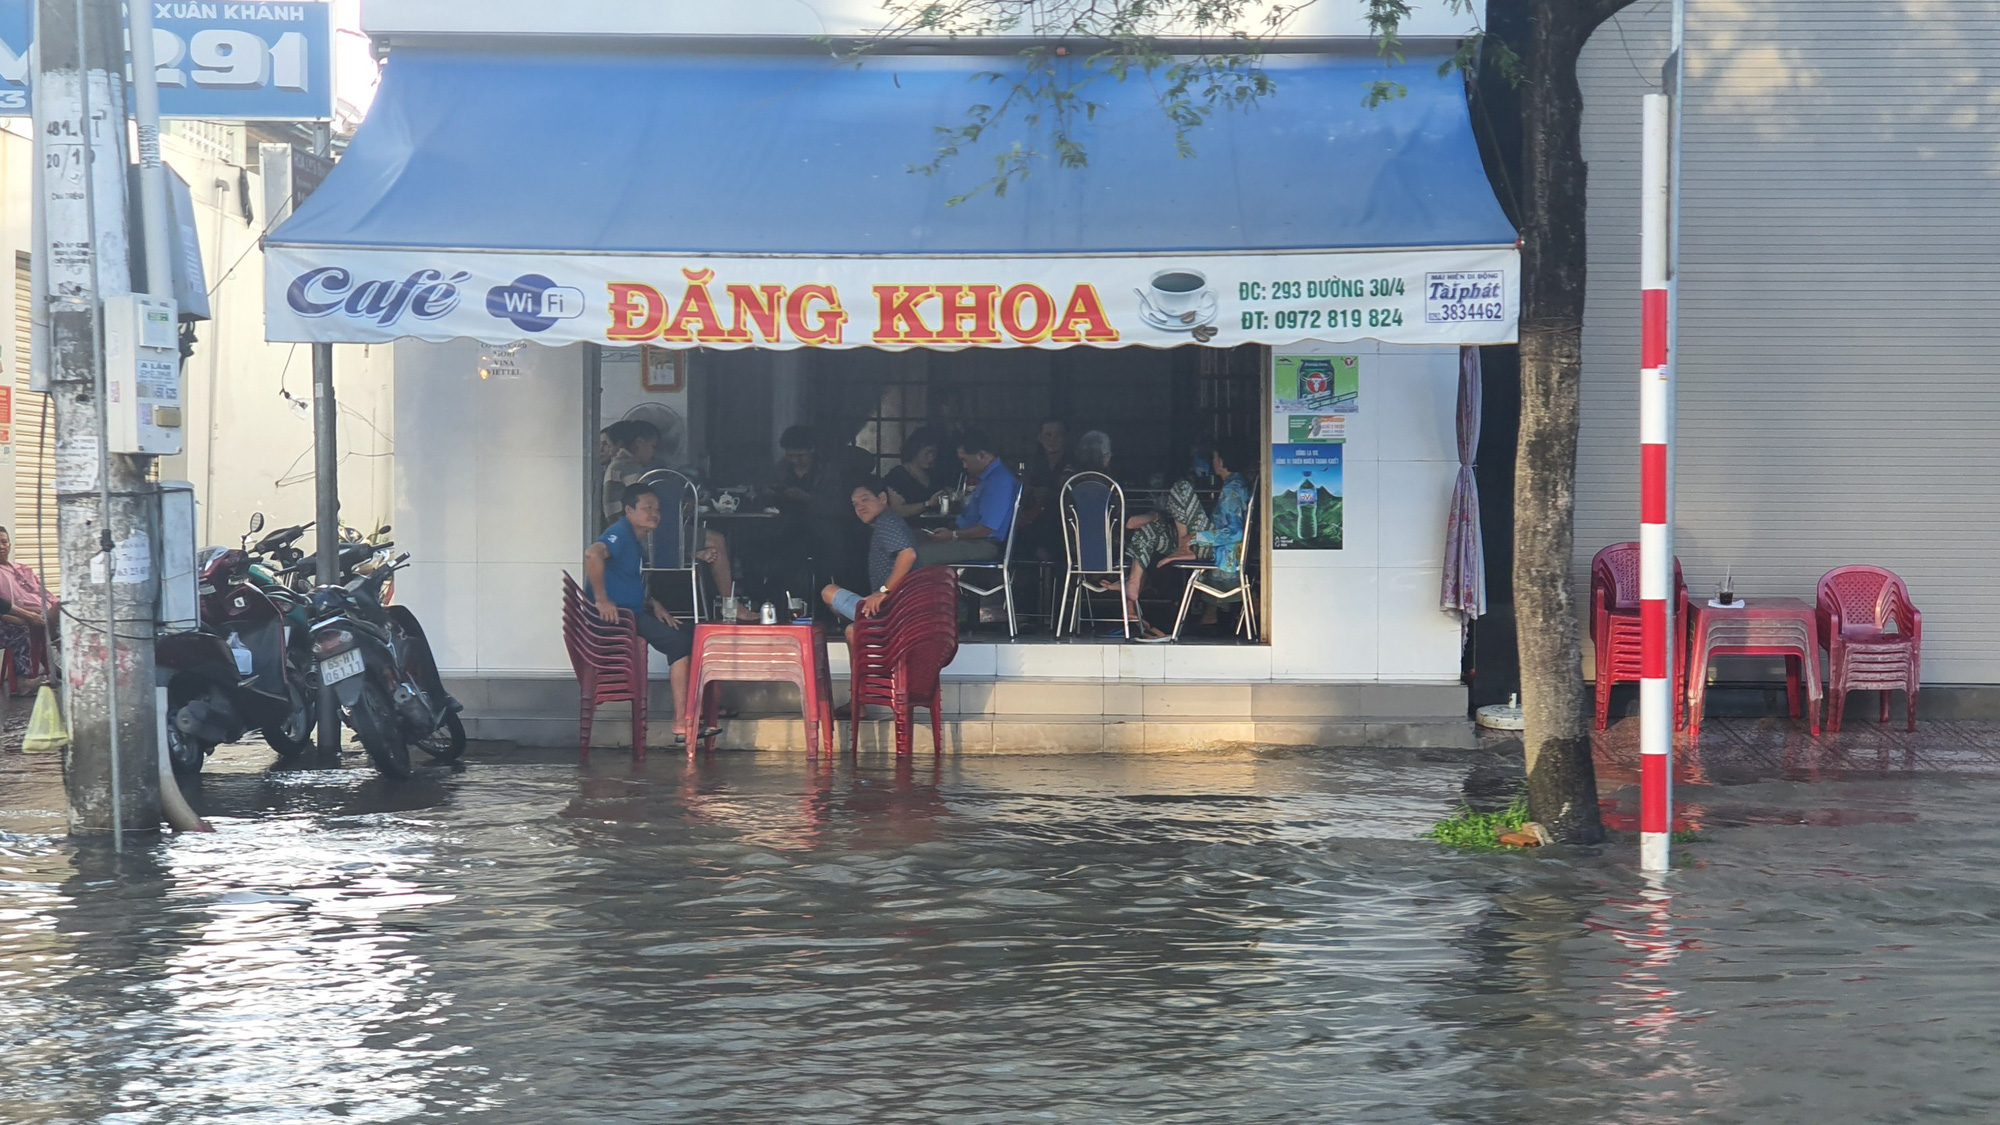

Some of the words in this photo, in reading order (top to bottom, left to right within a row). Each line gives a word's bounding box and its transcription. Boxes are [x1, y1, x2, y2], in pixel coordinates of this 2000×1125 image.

[155, 1, 217, 20] XUÂN
[224, 1, 304, 21] KHÁNH
[287, 266, 472, 327] Café
[1239, 281, 1267, 300] ĐC:
[1271, 281, 1302, 300] 293
[1307, 275, 1364, 298] ĐƯỜNG
[1369, 277, 1405, 297] 30/4
[606, 267, 849, 344] ĐĂNG
[872, 281, 1120, 344] KHOA
[1442, 302, 1502, 321] 3834462
[1241, 310, 1269, 330] ĐT:
[1275, 310, 1322, 330] 0972
[1327, 309, 1362, 328] 819
[1368, 308, 1403, 327] 824
[486, 368, 521, 376] VIETTEL
[494, 359, 515, 367] VINA
